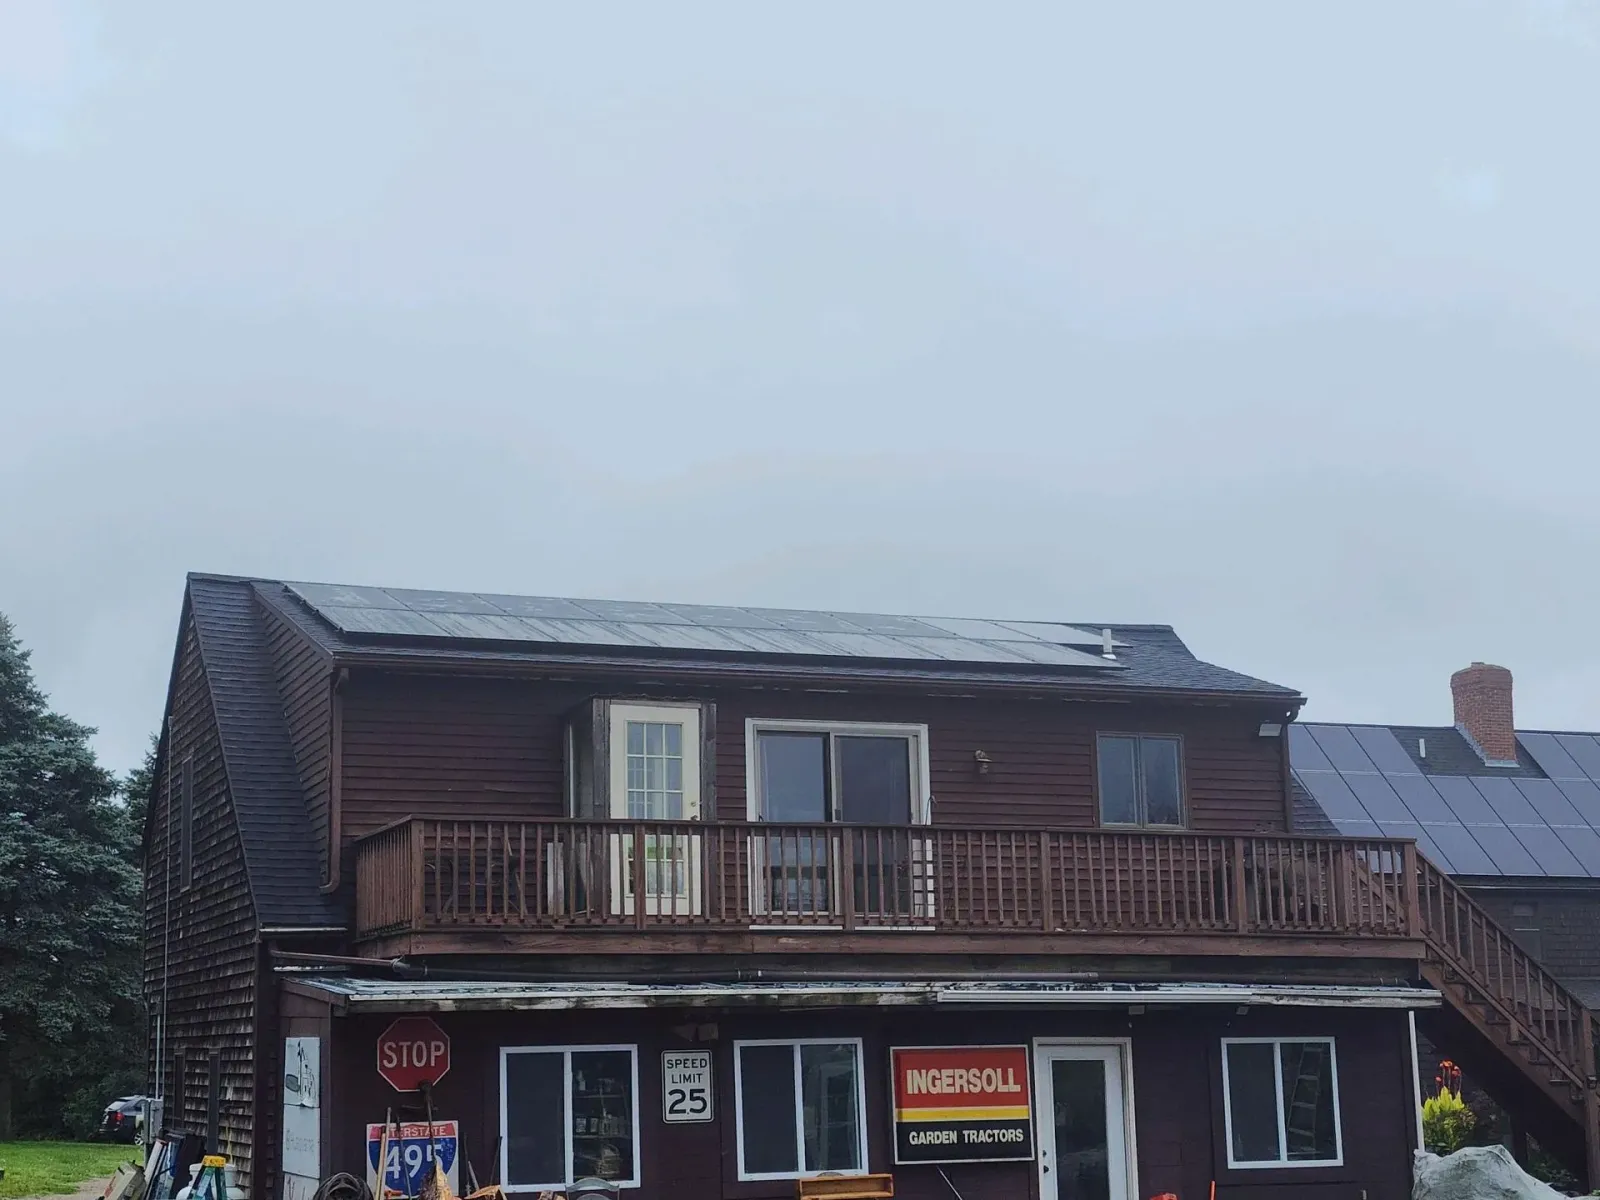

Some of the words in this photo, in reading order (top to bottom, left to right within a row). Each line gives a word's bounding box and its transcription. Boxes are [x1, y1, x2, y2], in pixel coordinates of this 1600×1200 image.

[382, 1040, 446, 1068] STOP
[666, 1058, 708, 1069] SPEED
[671, 1073, 703, 1084] LIMIT
[906, 1067, 1021, 1095] INGERSOLL
[668, 1088, 708, 1115] 25
[381, 1126, 446, 1138] TRSTATE
[909, 1130, 958, 1145] GARDEN
[962, 1128, 1024, 1143] TRACTORS
